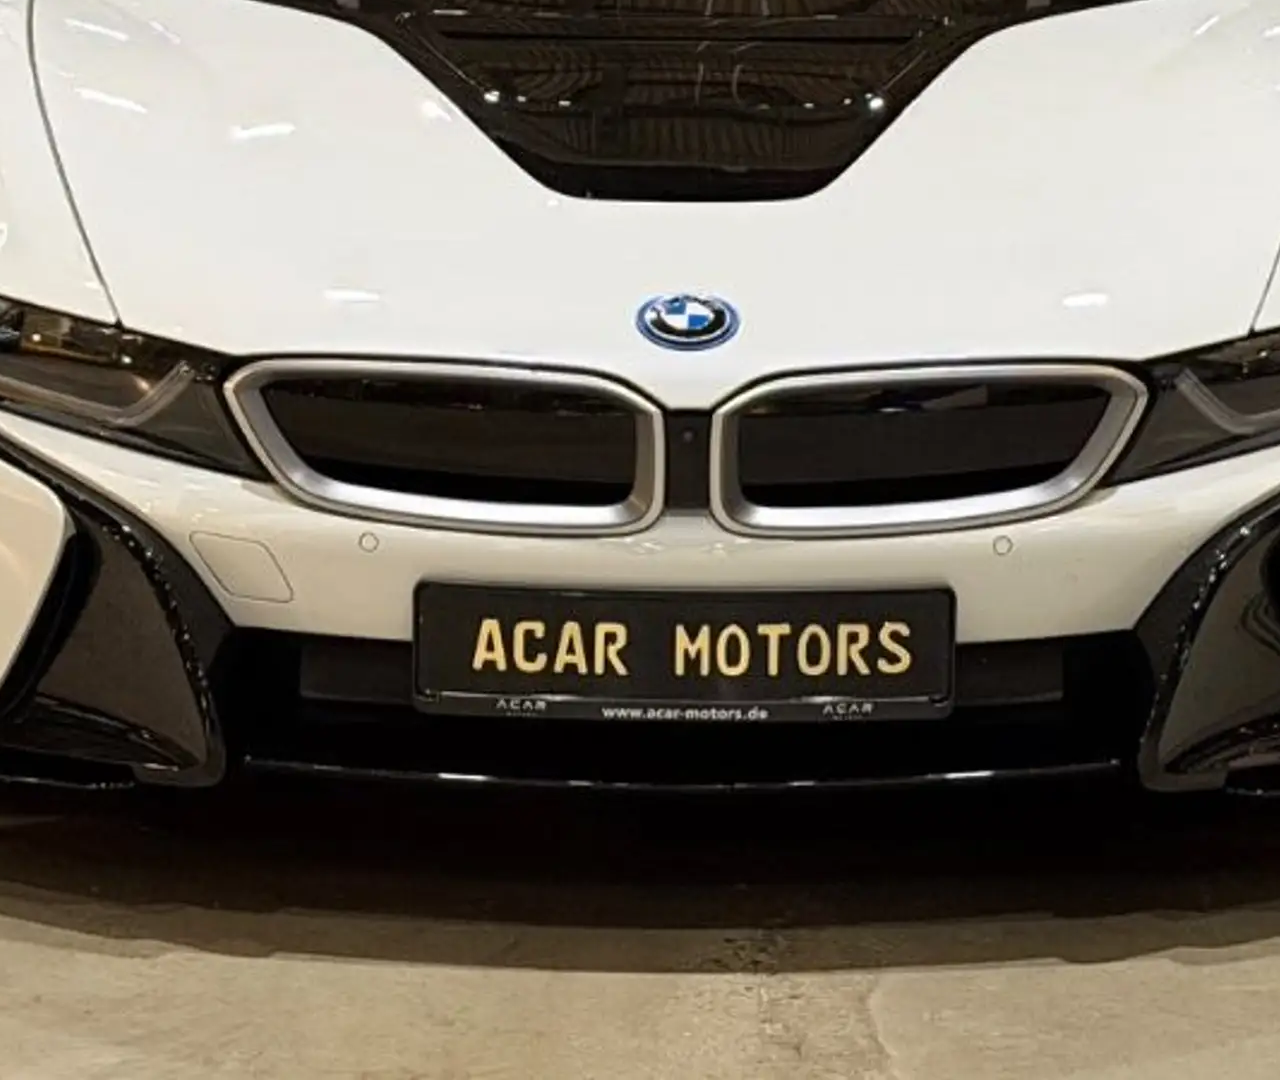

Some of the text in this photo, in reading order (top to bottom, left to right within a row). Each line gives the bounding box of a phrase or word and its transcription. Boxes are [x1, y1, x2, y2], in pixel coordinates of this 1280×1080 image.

[472, 618, 912, 677] ACAR MOTORS
[496, 698, 547, 711] ACAR
[822, 703, 873, 716] ACAR
[601, 706, 769, 721] www.acar-motors.de
